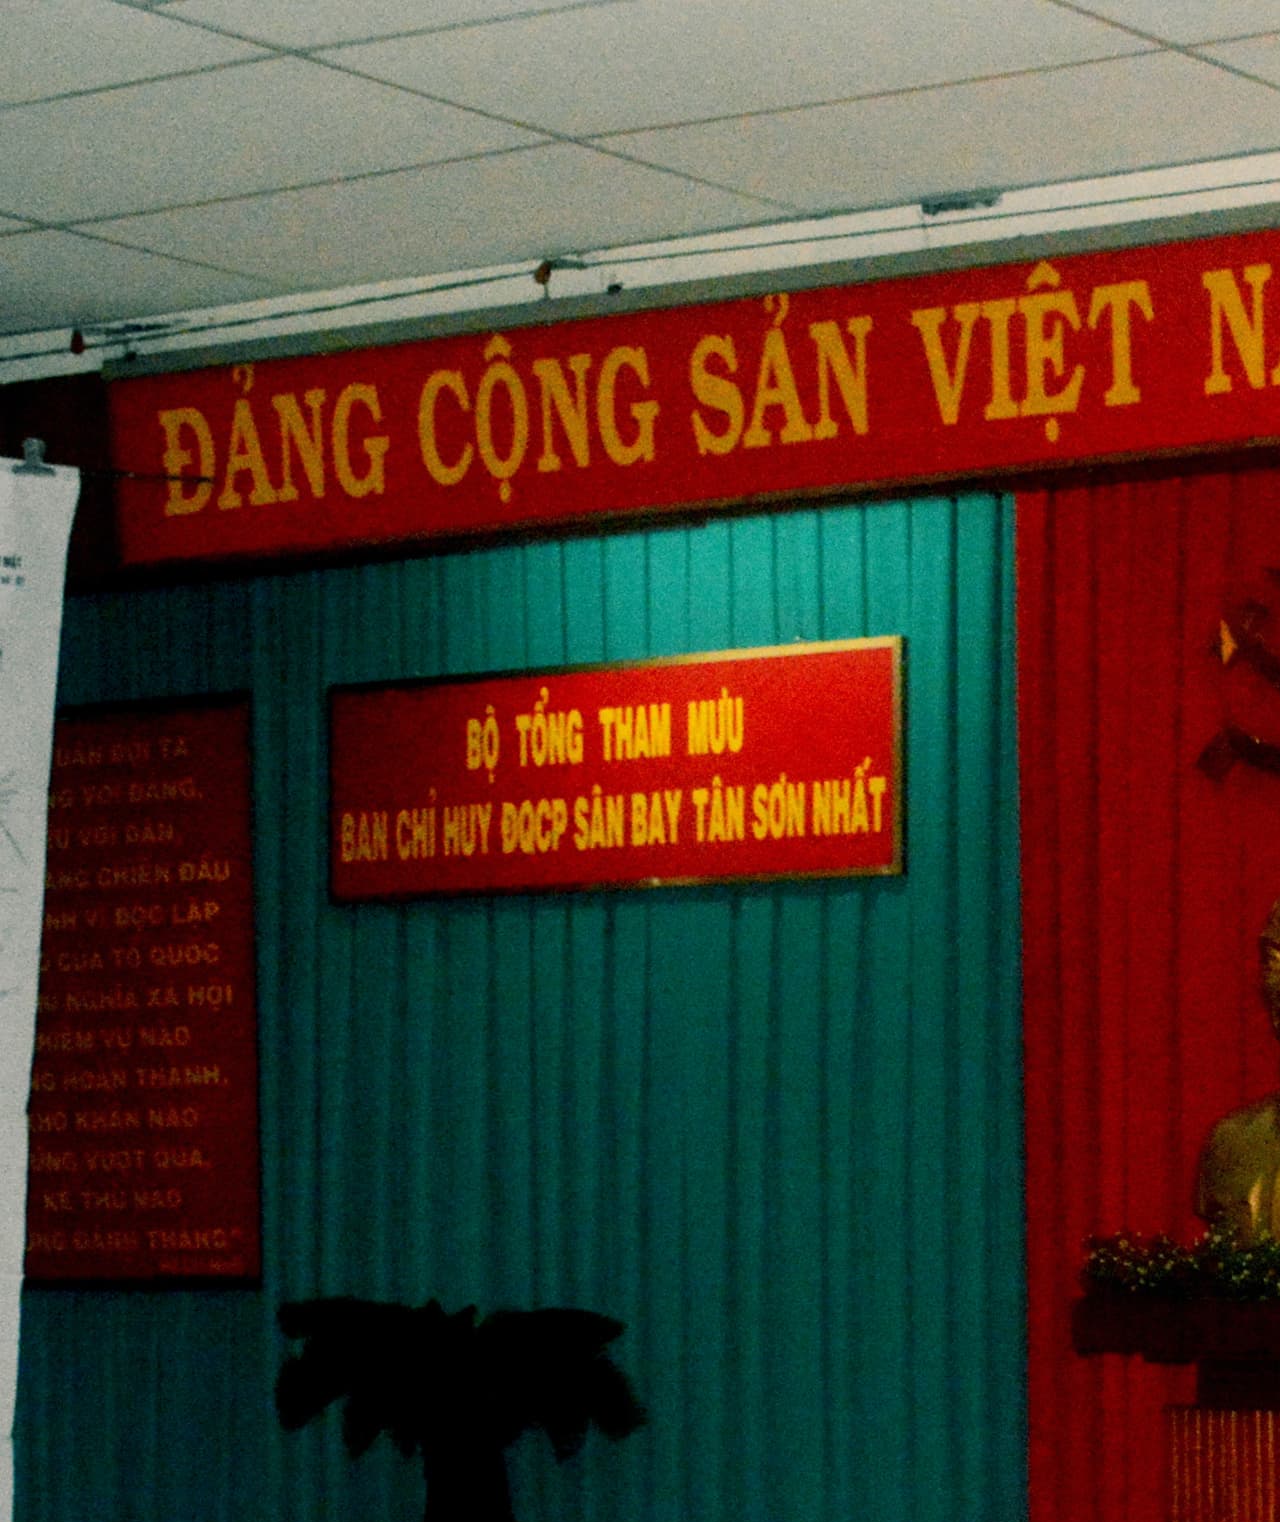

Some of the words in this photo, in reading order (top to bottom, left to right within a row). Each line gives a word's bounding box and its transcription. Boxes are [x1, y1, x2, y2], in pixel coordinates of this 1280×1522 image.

[159, 363, 389, 517] ĐẢNG
[418, 334, 660, 502] CỘNG
[691, 293, 871, 457] SẢN
[911, 261, 1153, 442] VIỆT
[466, 704, 499, 783] BỘ
[516, 686, 584, 767] TỔNG
[599, 703, 670, 761] THAM
[688, 686, 744, 755] MƯU
[341, 811, 388, 862] BAN
[397, 787, 436, 860] CHỈ
[443, 802, 492, 856] HUY
[501, 798, 568, 855] ĐQCP
[574, 784, 624, 848] SÂN
[631, 789, 682, 846] BAY
[692, 775, 744, 843] TÂN
[752, 771, 805, 840] SƠN
[813, 755, 886, 836] NHẤT
